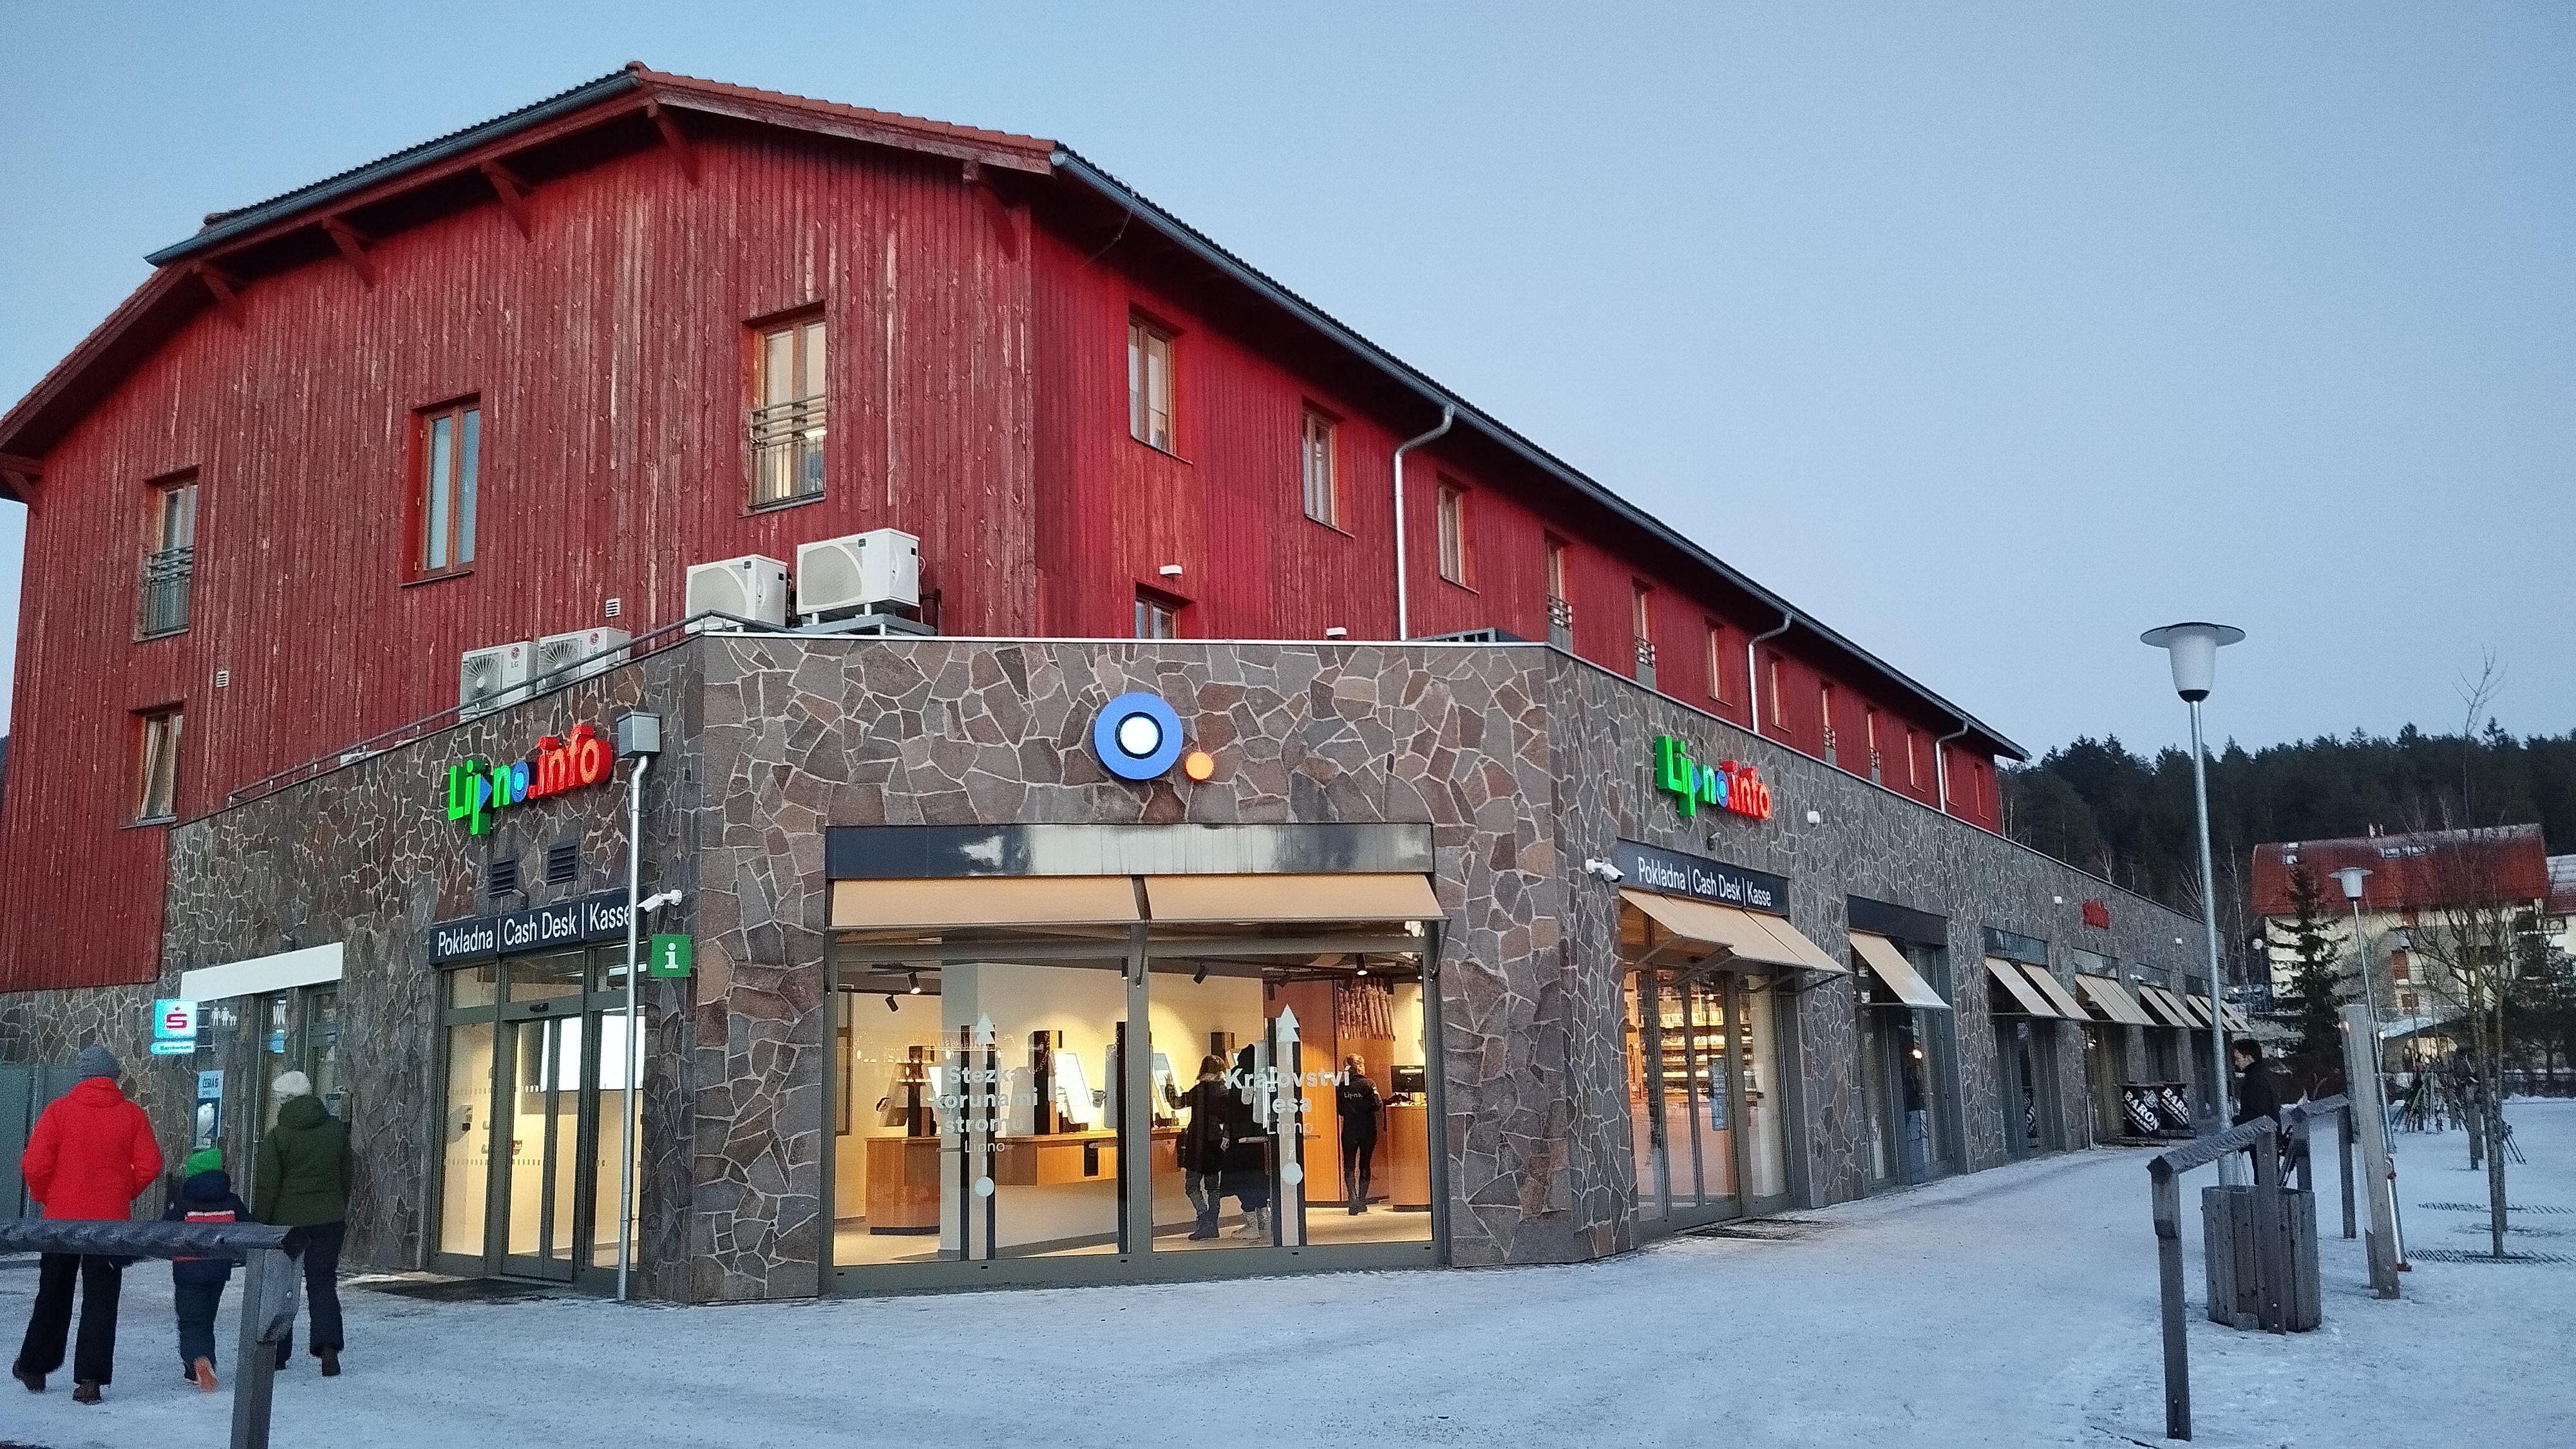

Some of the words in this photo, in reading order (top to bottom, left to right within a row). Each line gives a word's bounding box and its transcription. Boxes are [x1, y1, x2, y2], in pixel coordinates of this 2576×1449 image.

[511, 660, 519, 668] LG
[1638, 857, 1686, 891] Pokladna
[1693, 869, 1717, 896] Cash
[1718, 873, 1741, 902] Desk
[1747, 880, 1771, 907] Kasse
[438, 925, 493, 956] Pokladna
[504, 914, 537, 946] Cash
[542, 907, 577, 940] Desk
[590, 902, 629, 931] Kasse
[1226, 1066, 1351, 1090] Království
[936, 1087, 1038, 1110] korunami
[2125, 1090, 2159, 1130] BARON
[2162, 1088, 2190, 1122] BARO
[1267, 1119, 1314, 1137] Lipno
[965, 1139, 1005, 1156] Lipno
